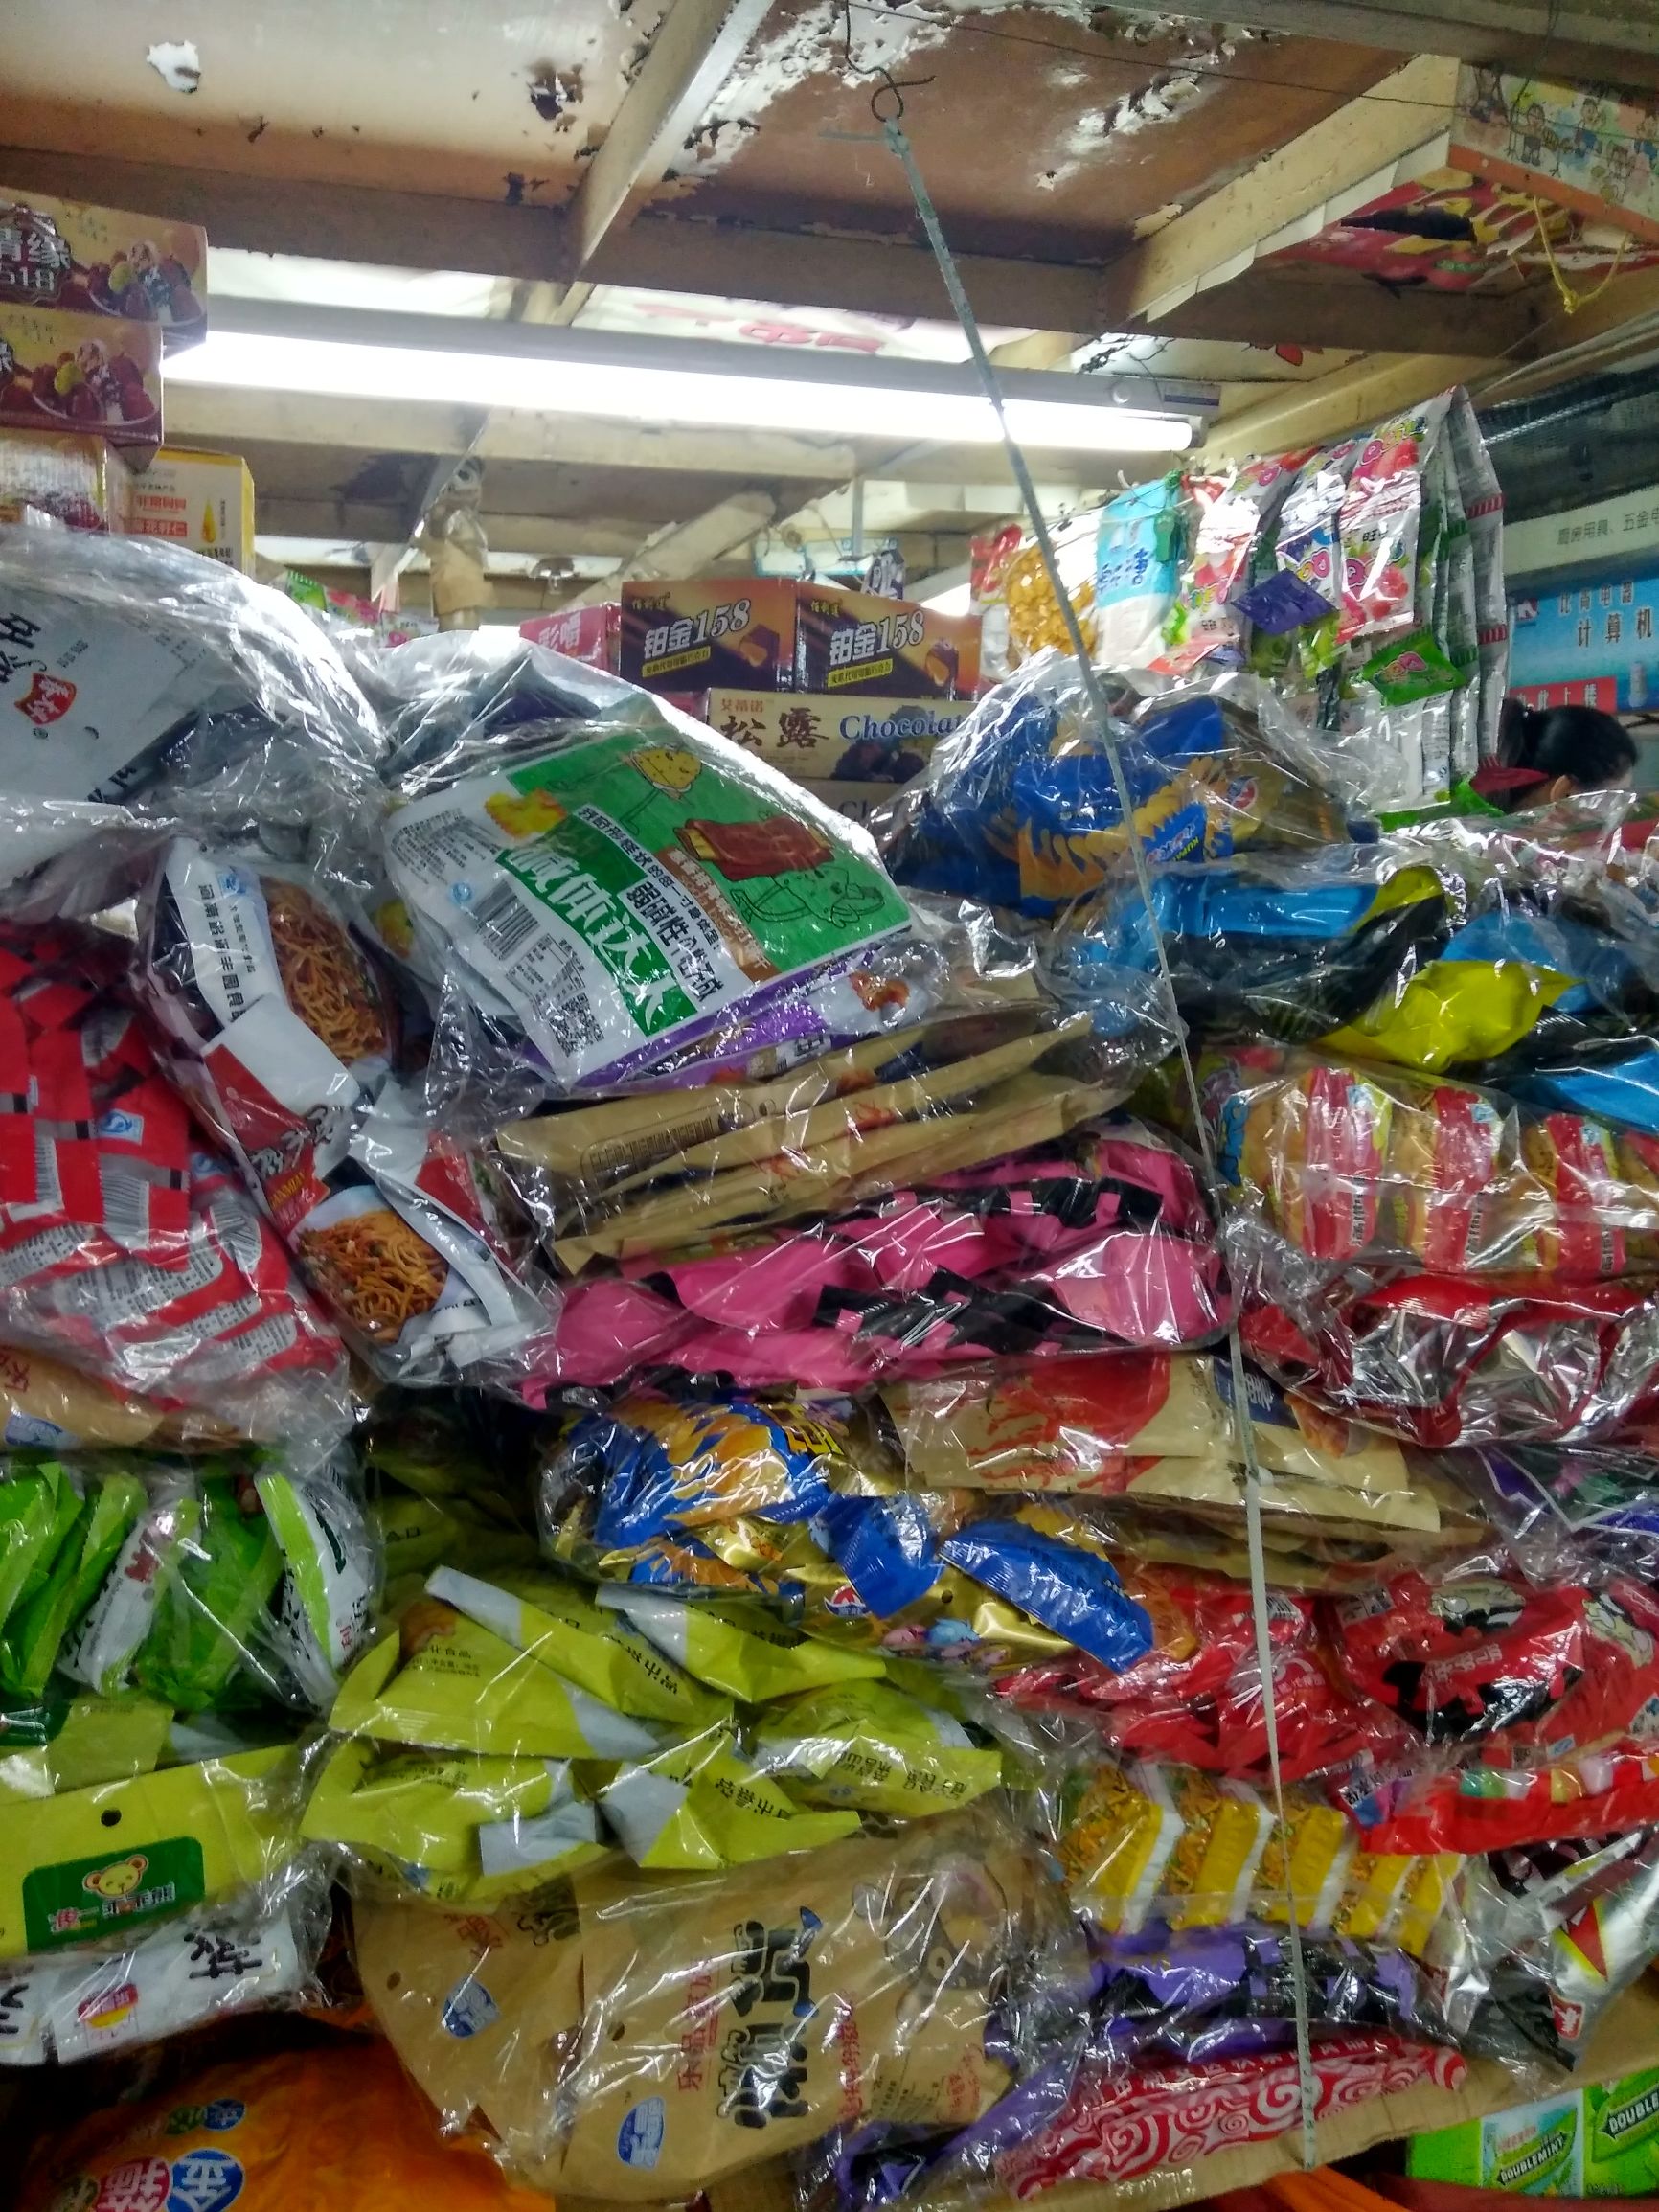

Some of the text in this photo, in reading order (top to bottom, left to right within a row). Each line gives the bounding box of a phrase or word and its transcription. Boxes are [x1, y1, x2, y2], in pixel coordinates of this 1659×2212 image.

[644, 598, 752, 660] 铂金158
[830, 609, 925, 666] 铂金158
[1577, 608, 1653, 649] 计算机
[720, 707, 830, 749] 松露
[1499, 2136, 1565, 2184] DOUBLEMINT
